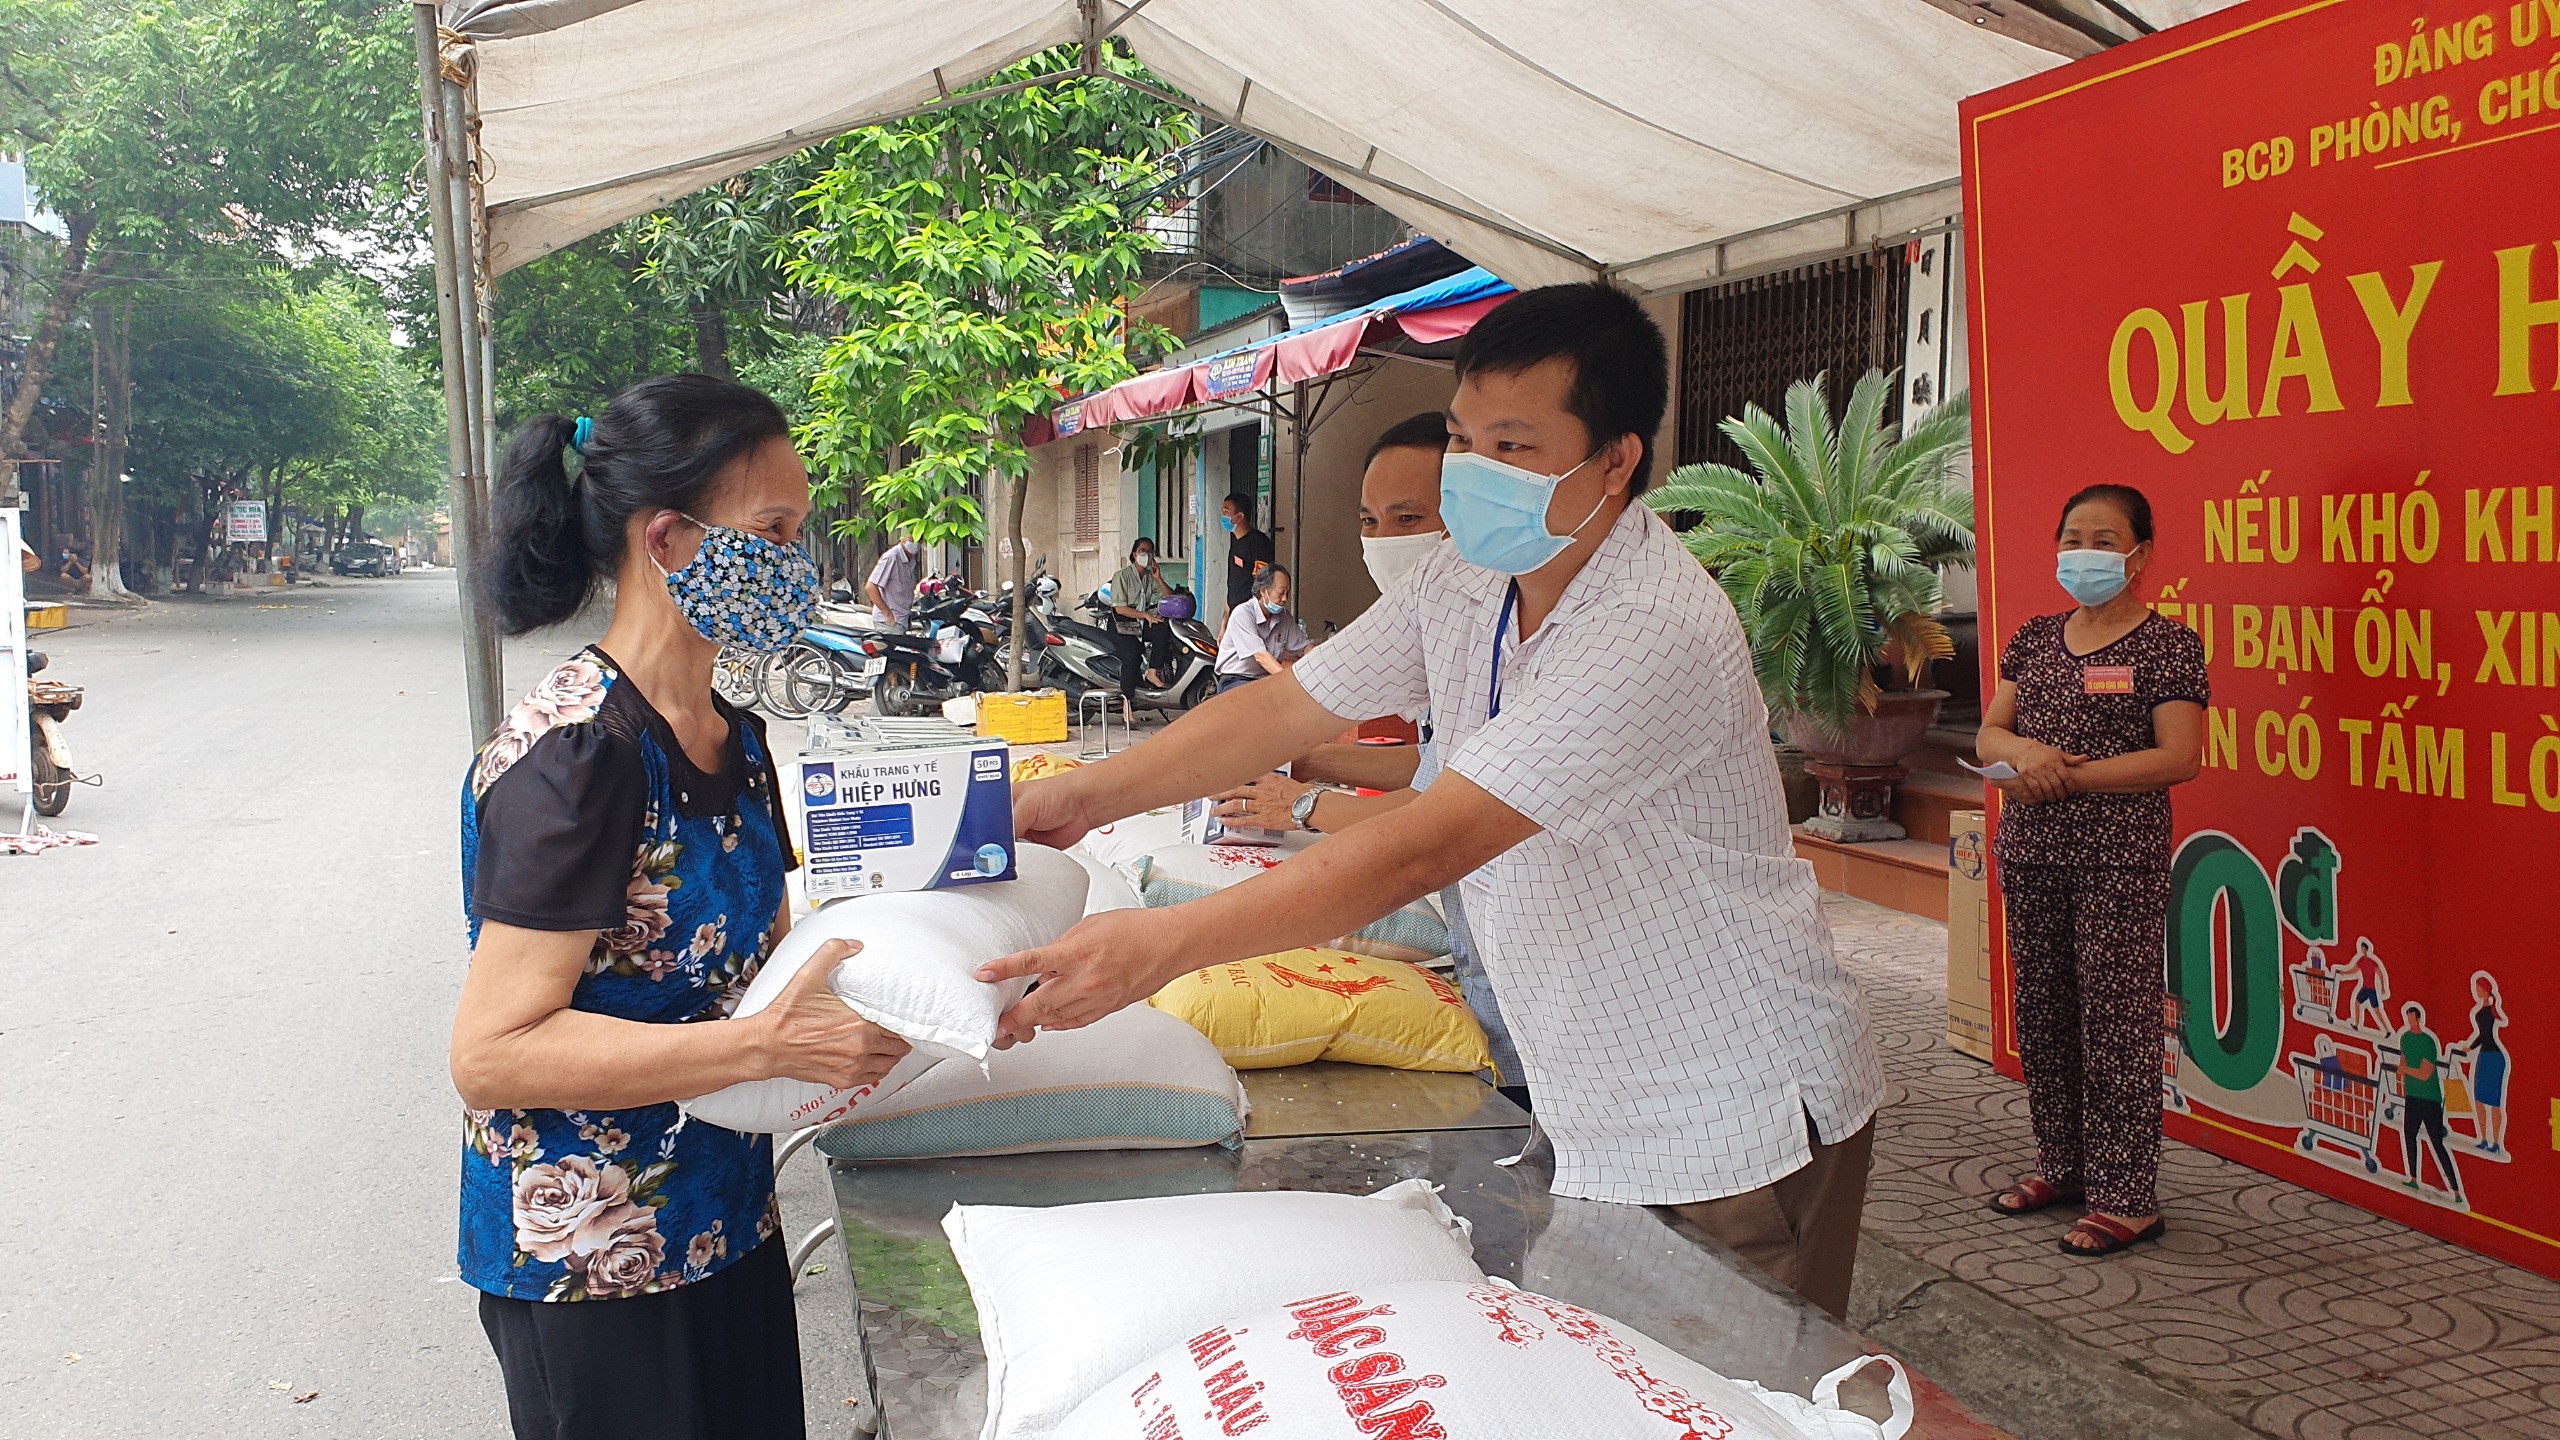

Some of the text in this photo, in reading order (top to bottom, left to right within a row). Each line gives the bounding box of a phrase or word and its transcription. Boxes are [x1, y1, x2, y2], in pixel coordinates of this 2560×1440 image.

[2374, 14, 2494, 86] ĐẢNG
[2221, 136, 2295, 188] BCĐ
[2310, 95, 2462, 167] PHÒNG,
[2107, 211, 2444, 454] QUẦY
[2203, 470, 2560, 564] NẾU KHÓ KH
[2233, 604, 2334, 686] BẠN
[2354, 569, 2451, 697] ỔN,
[841, 759, 938, 779] KHẨU TRANG Y TẾ
[976, 759, 989, 769] 50
[2254, 696, 2322, 781] CÓ
[2339, 695, 2465, 800] TẤM
[842, 779, 941, 805] HIỆP HƯNG
[789, 1095, 826, 1122] 10KG
[1203, 1360, 1271, 1438] HẬU
